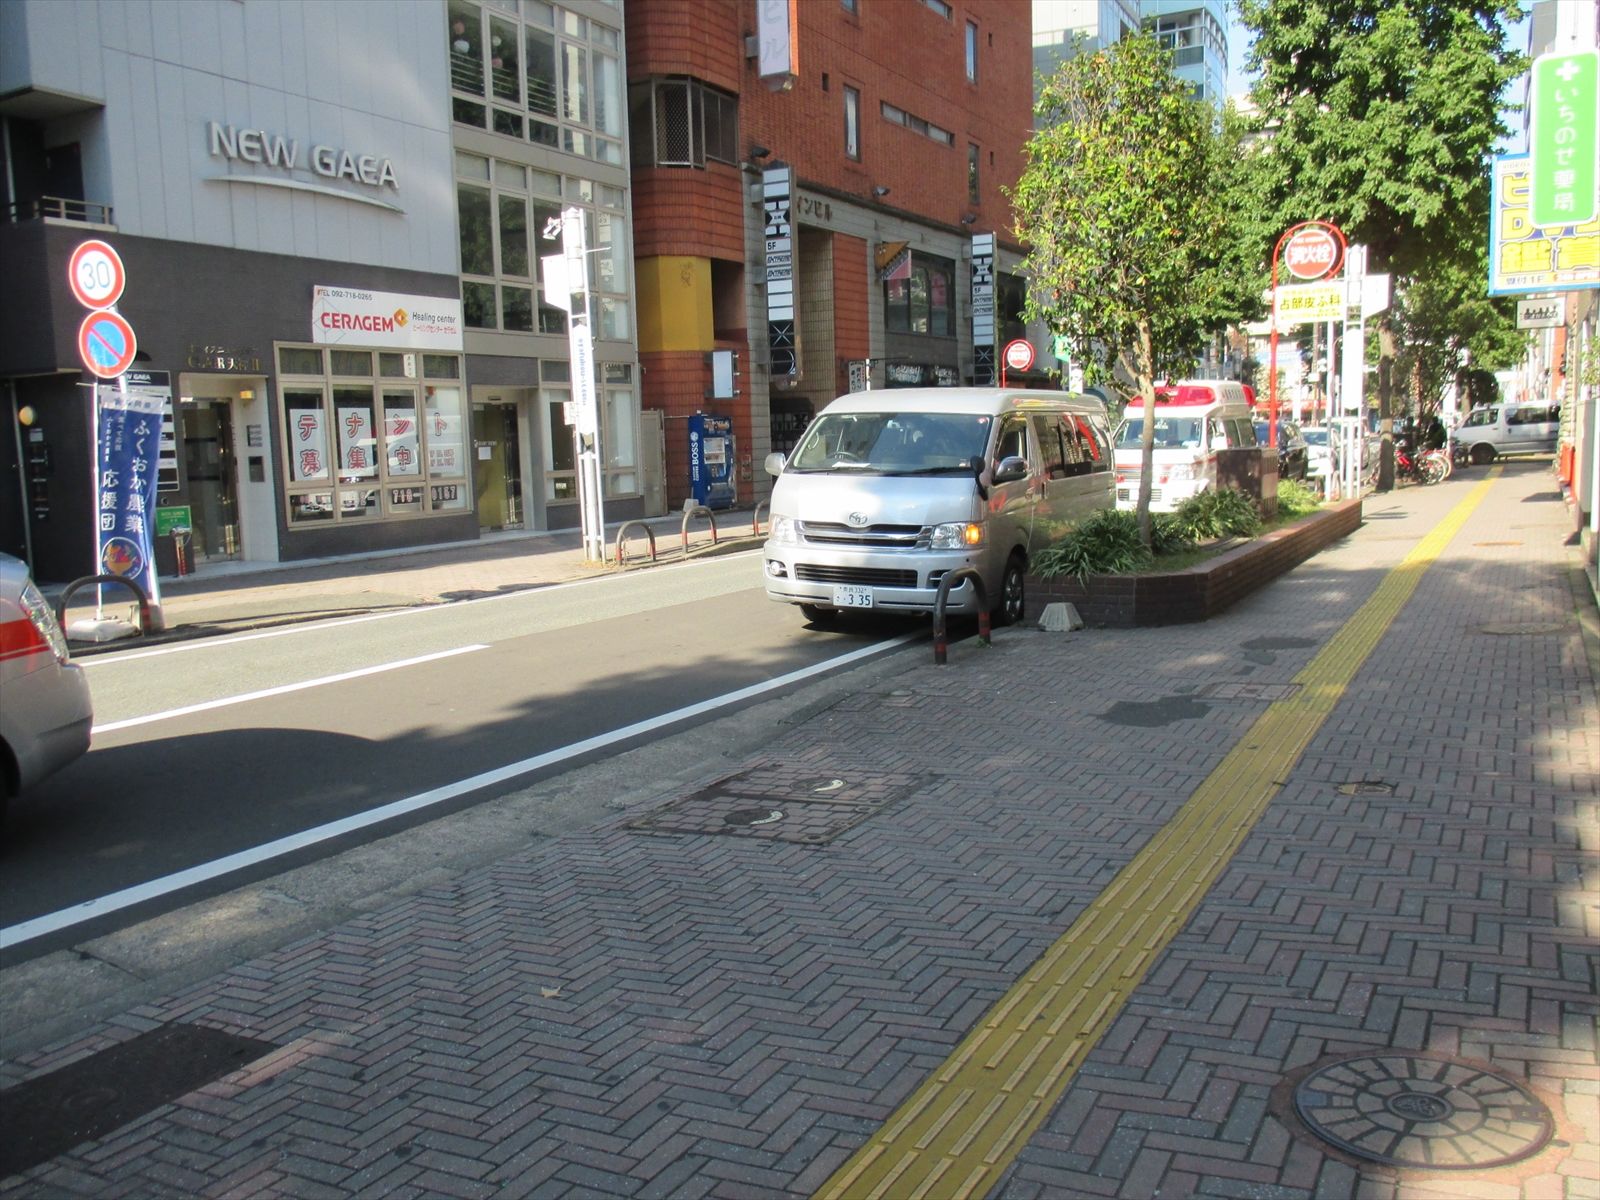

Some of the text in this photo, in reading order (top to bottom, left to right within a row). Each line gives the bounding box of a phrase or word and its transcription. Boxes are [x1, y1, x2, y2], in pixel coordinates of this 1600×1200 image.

[209, 120, 401, 190] NEW GAEA
[1552, 88, 1578, 213] いちのせ薬局
[82, 260, 111, 291] 30
[320, 312, 394, 333] CERAGEM
[412, 311, 456, 324] Healing center
[125, 419, 151, 534] ふくおか農業
[690, 442, 699, 465] BOSS
[100, 468, 119, 531] 応援団
